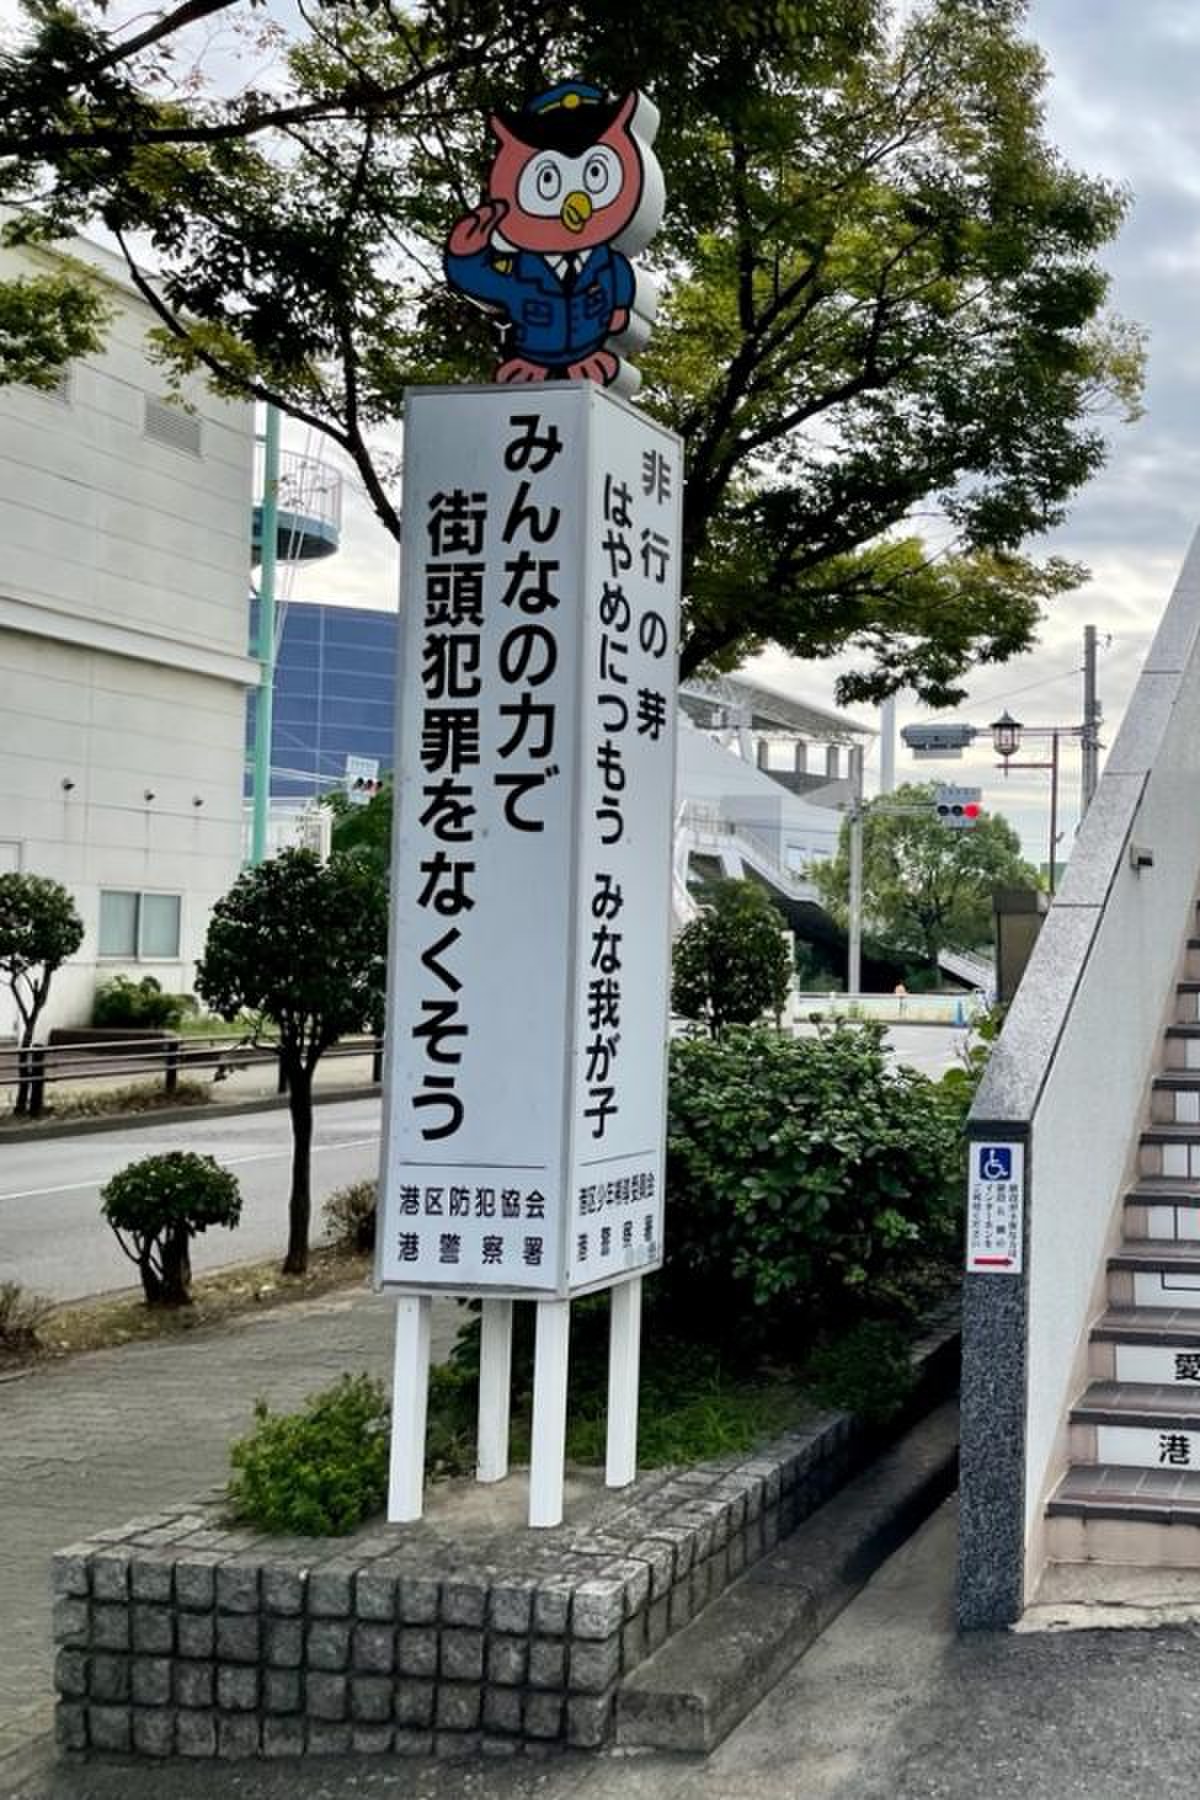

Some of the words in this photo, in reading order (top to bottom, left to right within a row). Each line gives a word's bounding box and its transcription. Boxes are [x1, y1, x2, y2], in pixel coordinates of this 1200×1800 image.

[494, 414, 564, 833] みんなの力で
[596, 473, 633, 845] はやめにつもう
[636, 449, 672, 742] 非行の芽
[412, 489, 489, 1141] 街頭犯罪をなくそう
[583, 873, 625, 1139] みな我が子
[397, 1231, 544, 1266] 港警察署
[399, 1184, 545, 1221] 港区防犯協会
